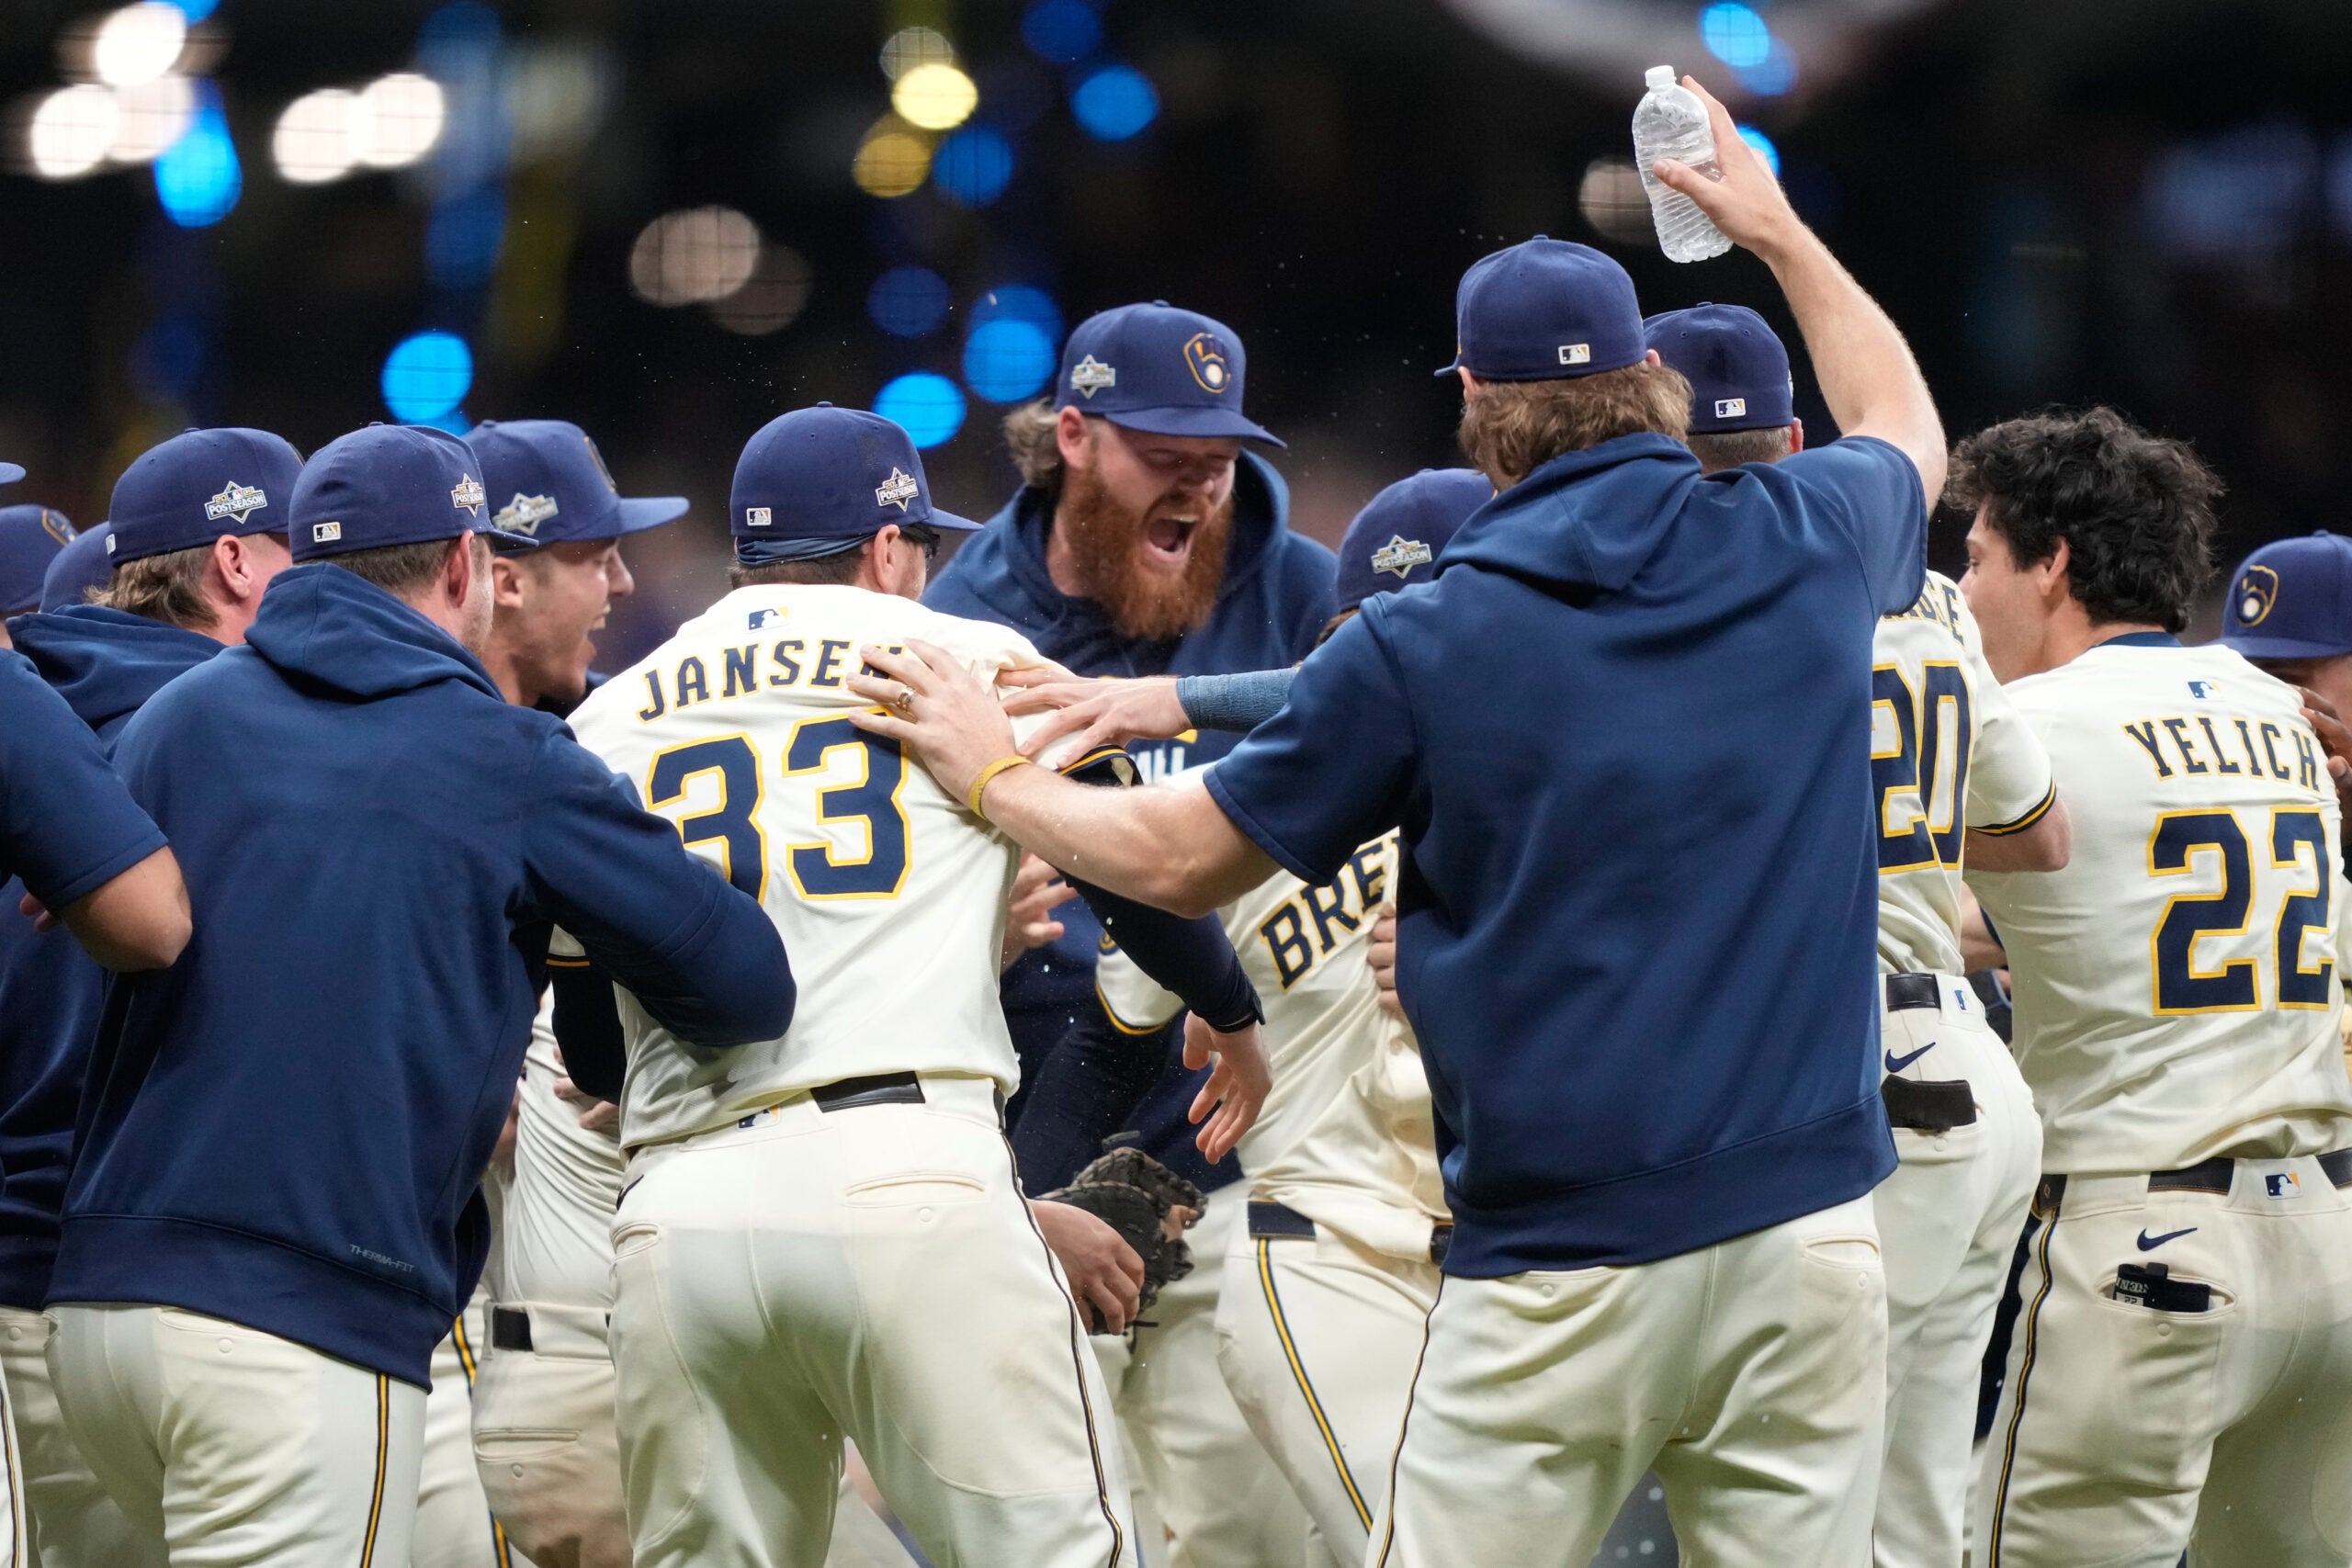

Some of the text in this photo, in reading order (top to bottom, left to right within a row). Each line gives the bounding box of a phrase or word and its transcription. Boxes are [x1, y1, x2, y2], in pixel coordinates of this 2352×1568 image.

[208, 494, 265, 515] POSTSEASON
[215, 495, 228, 503] 20
[645, 706, 912, 907] 33
[1871, 660, 1974, 874] 20
[2123, 716, 2322, 794] YELICH
[1258, 836, 1400, 994] BRE
[2147, 807, 2335, 1016] 22
[350, 1243, 414, 1272] THERMA-FIT
